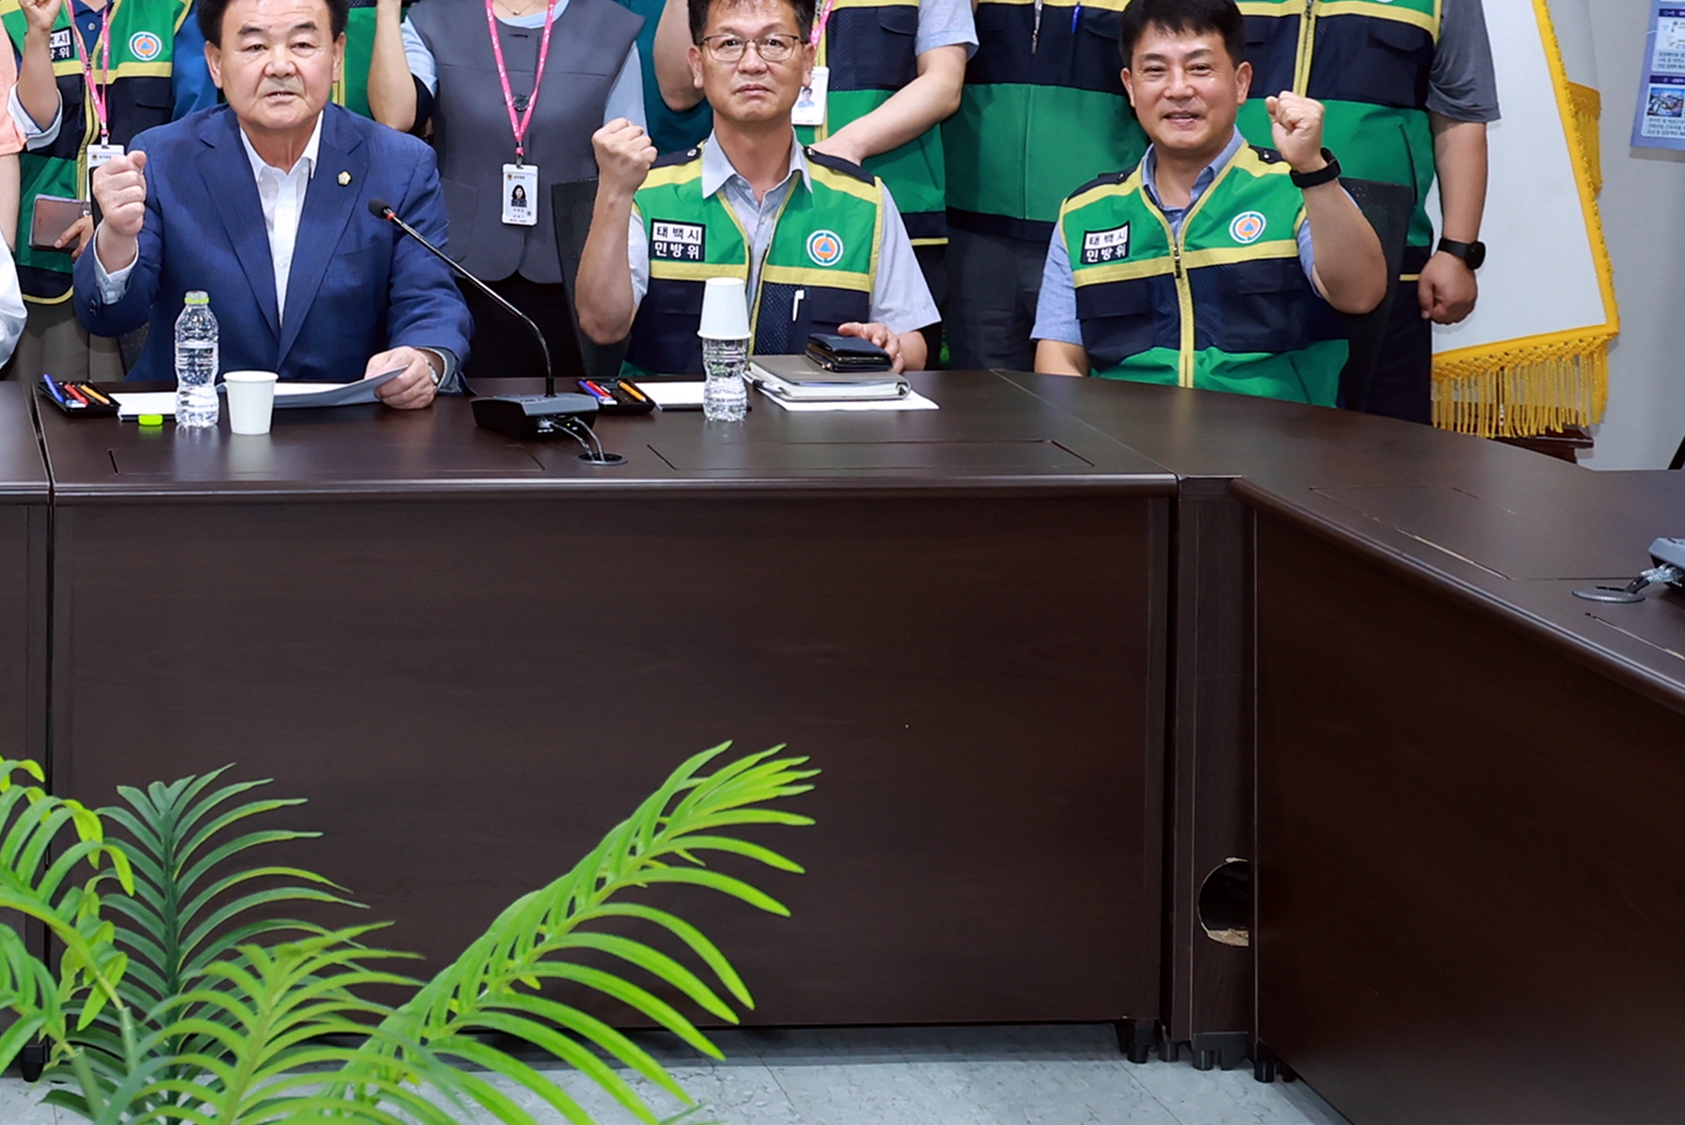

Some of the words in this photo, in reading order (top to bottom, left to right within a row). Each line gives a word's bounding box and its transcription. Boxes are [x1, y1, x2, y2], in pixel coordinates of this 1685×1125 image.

[656, 226, 700, 242] 태백시
[654, 242, 700, 260] 민방위
[1086, 243, 1126, 263] 민방위
